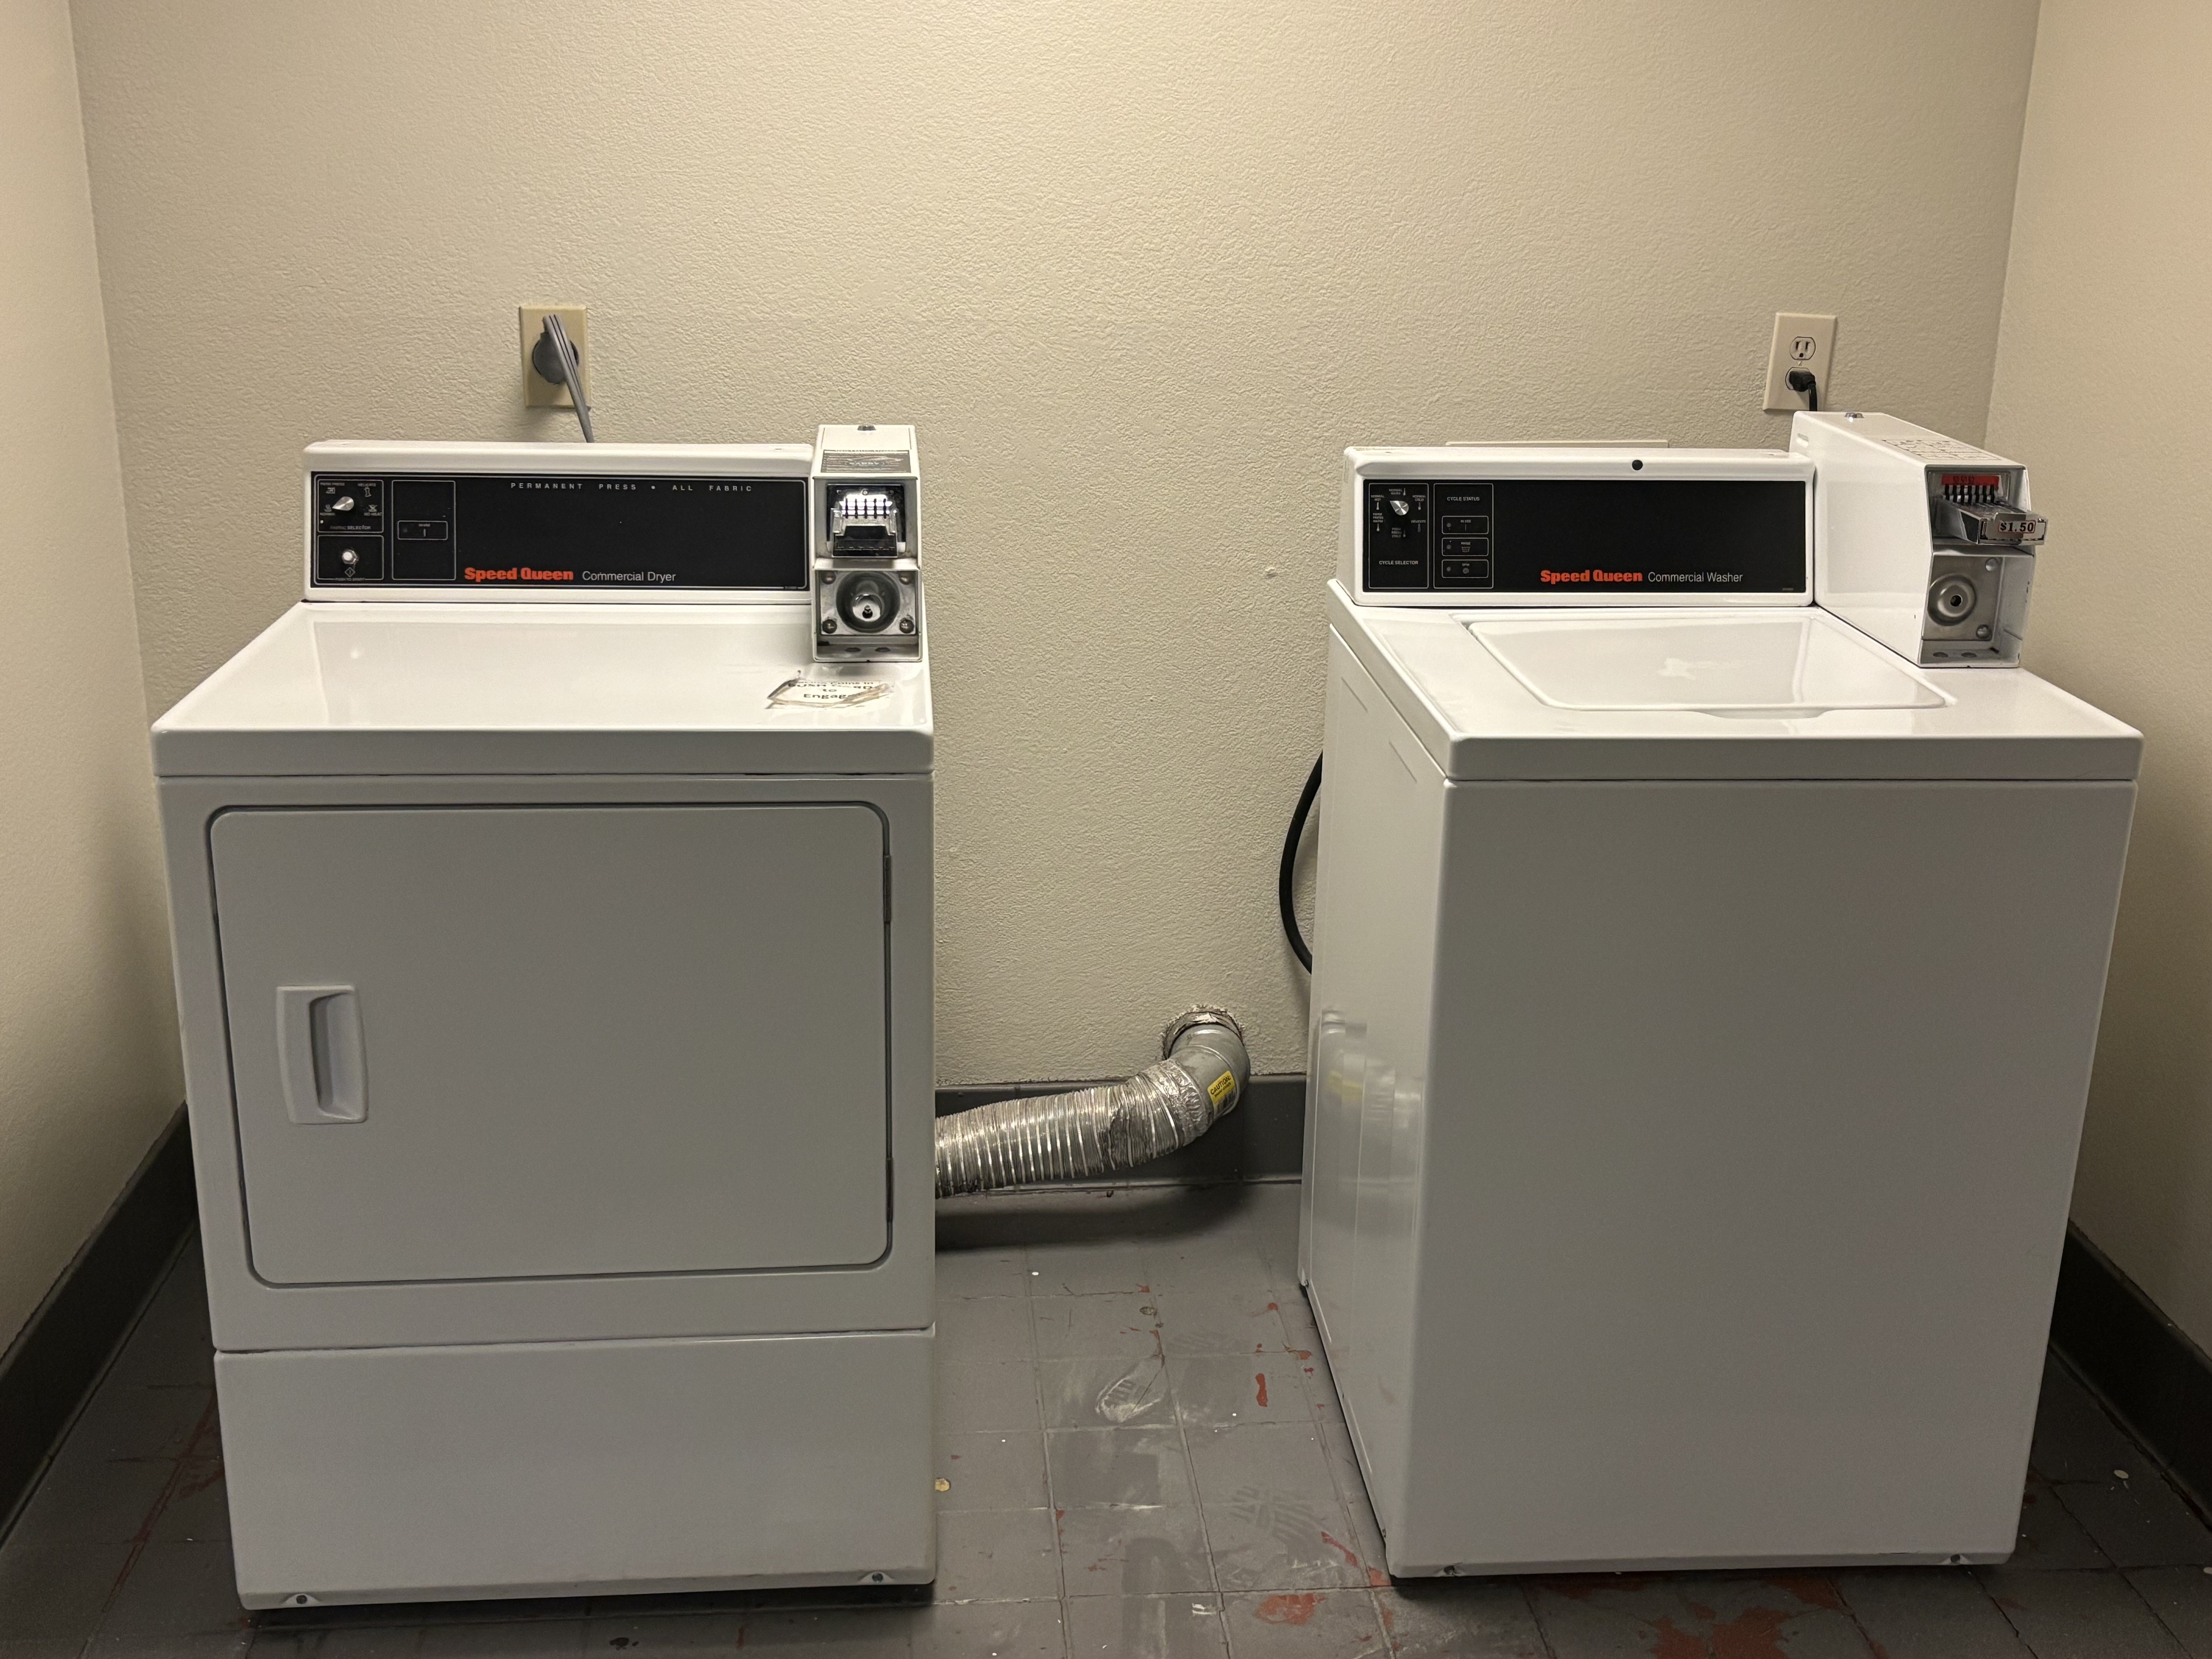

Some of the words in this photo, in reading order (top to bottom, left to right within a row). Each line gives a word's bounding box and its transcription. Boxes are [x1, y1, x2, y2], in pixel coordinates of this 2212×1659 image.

[2000, 522, 2034, 532] $1.50
[464, 567, 517, 582] Speed
[520, 567, 574, 580] Queen
[582, 571, 644, 581] Commercial
[647, 572, 676, 583] Dryer
[1540, 570, 1590, 584] Speed
[1593, 570, 1643, 582] Queen
[1648, 572, 1704, 582] Commercial
[1707, 572, 1743, 582] Washer
